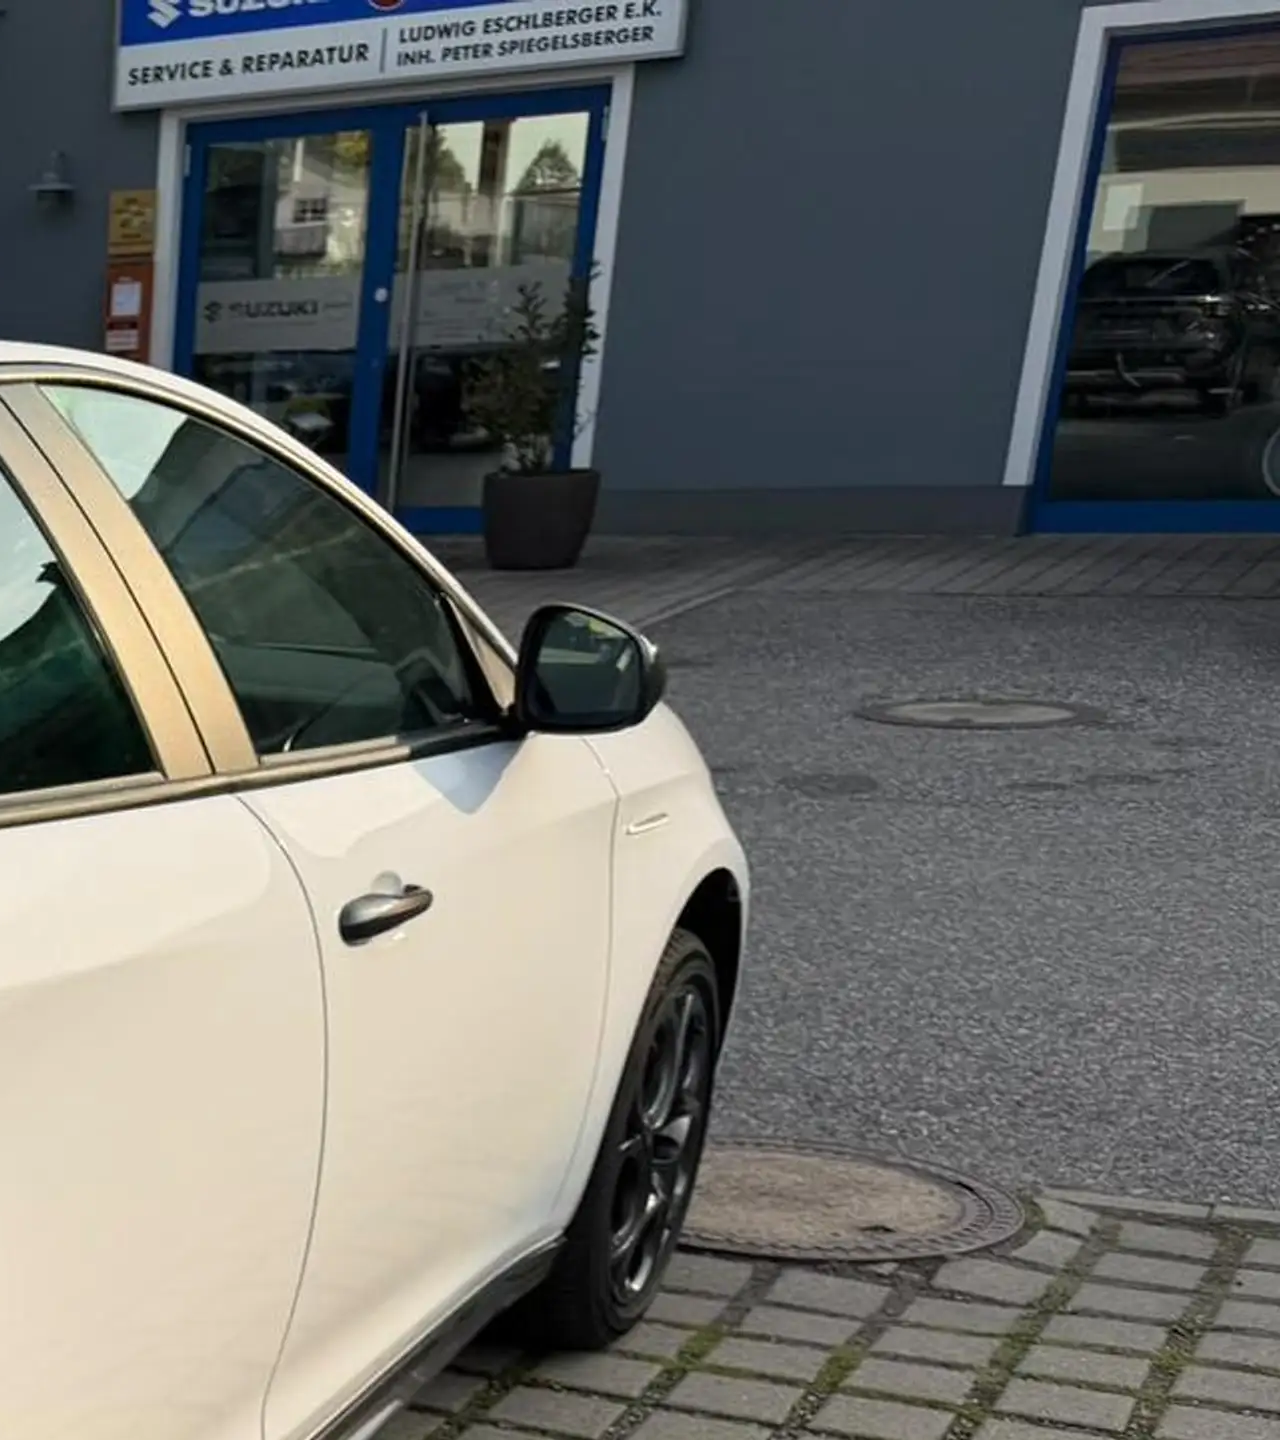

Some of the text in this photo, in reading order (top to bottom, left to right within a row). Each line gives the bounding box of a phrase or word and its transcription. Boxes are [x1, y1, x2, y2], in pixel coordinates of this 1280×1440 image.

[398, 20, 476, 45] LUDWIG
[481, 3, 618, 35] ESCHLBERGER
[127, 42, 370, 86] SERVICE & REPARATUR
[396, 25, 655, 67] INH. PETER SPIEGELSBERGER
